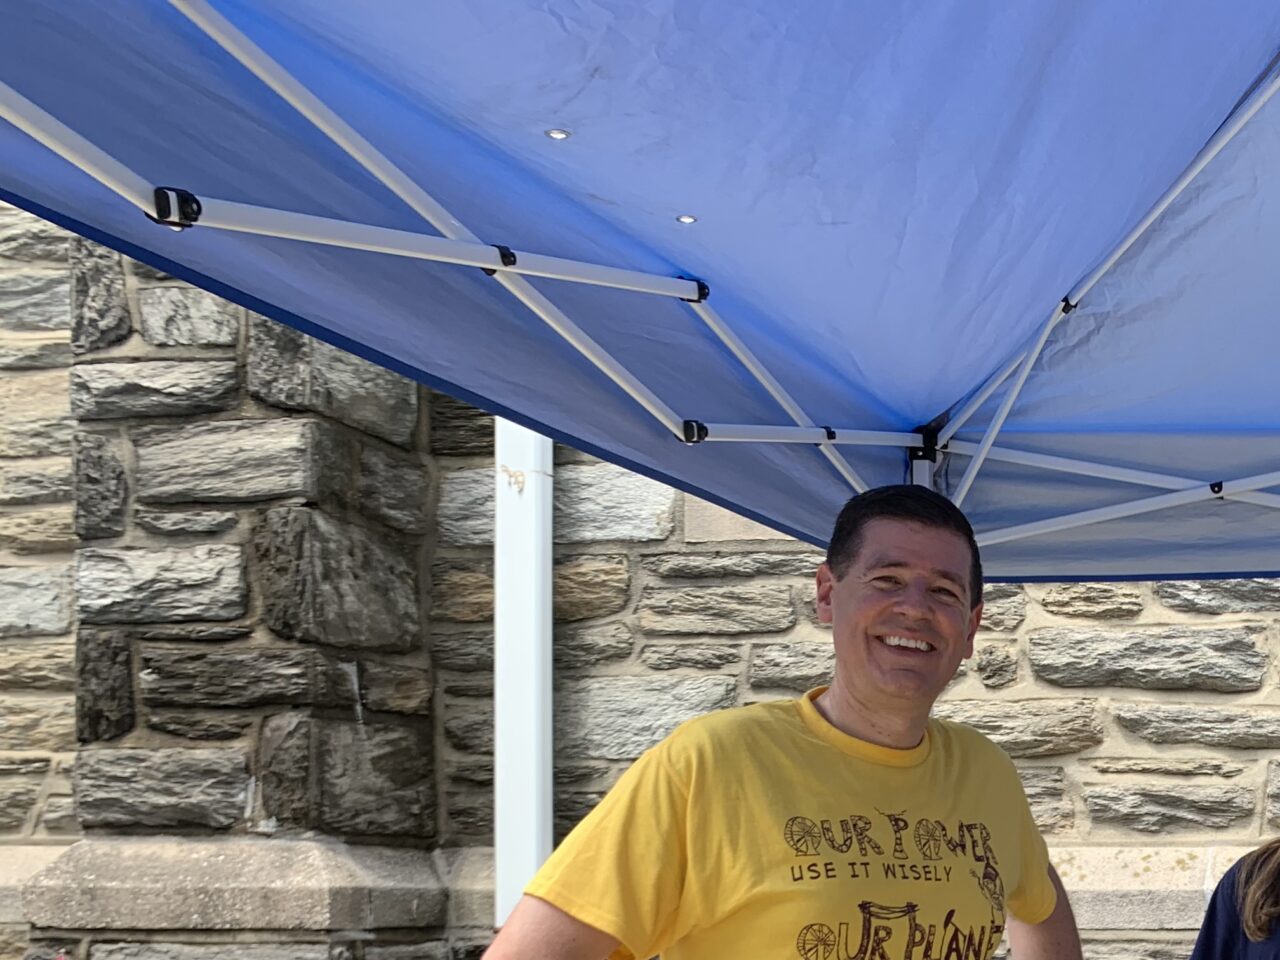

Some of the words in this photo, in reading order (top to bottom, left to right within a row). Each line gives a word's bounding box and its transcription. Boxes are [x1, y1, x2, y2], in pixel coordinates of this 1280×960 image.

[784, 815, 884, 857] OUR
[878, 809, 998, 865] POWER
[791, 862, 837, 882] USE
[848, 862, 871, 879] IT
[882, 862, 952, 882] WISELY
